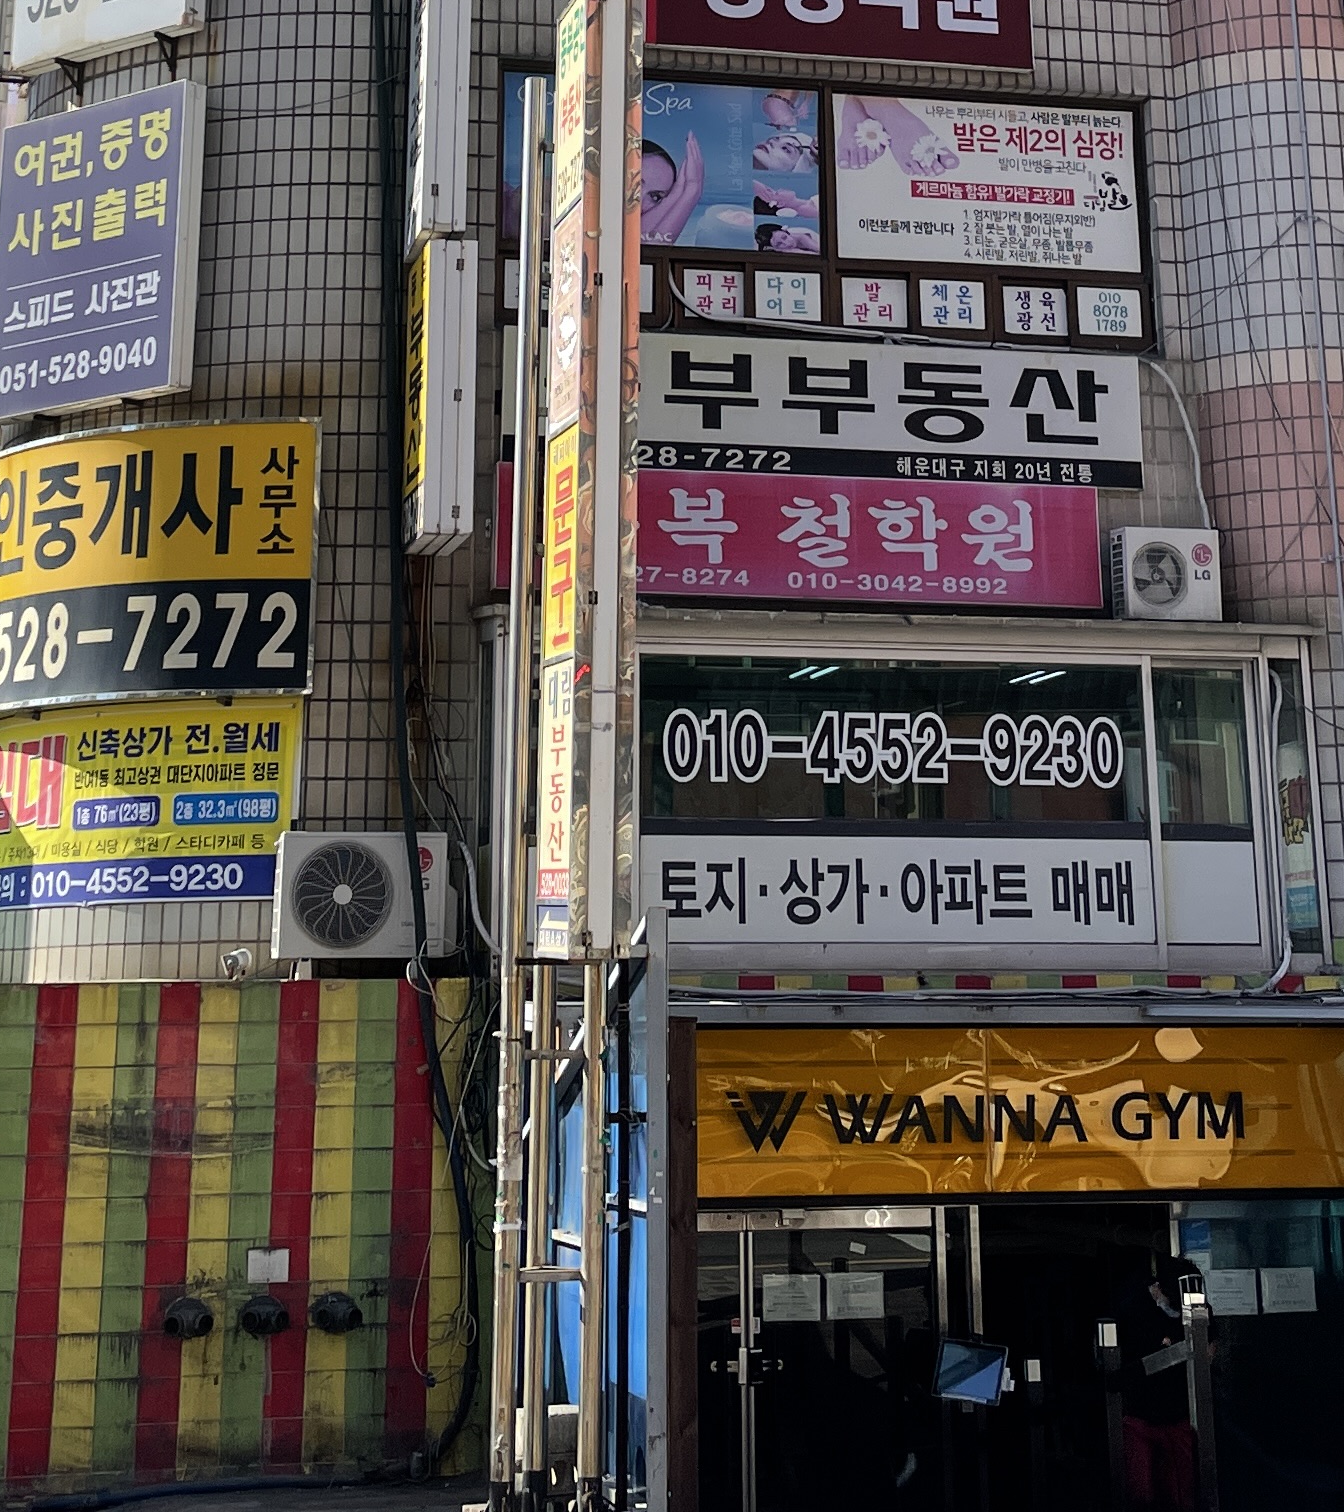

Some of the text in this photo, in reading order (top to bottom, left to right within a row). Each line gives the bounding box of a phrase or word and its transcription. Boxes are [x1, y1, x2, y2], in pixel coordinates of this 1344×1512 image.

[643, 83, 693, 115] Spa
[953, 123, 1067, 156] 발은 제2의
[696, 274, 737, 290] 피부
[865, 283, 1121, 304] 발 010
[3, 270, 161, 335] 스피드 사진관
[853, 303, 972, 325] 관리 관리
[1093, 305, 1128, 319] 8078
[1096, 318, 1127, 333] 1789
[0, 335, 157, 395] 051-528-9040
[897, 457, 1093, 484] 해운대구 지회 20년 전통
[778, 493, 1034, 573] 철학원
[788, 571, 1008, 595] 010-3042-8992
[1194, 569, 1212, 581] LG
[77, 726, 172, 762] 신축상가
[662, 708, 1125, 790] 010-4552-9230
[113, 762, 279, 787] 최고상권 대단지아파트 정문
[547, 724, 567, 862] 부동산
[32, 863, 243, 899] 010-4552-9230
[1054, 859, 1135, 926] 매매
[823, 1091, 1247, 1145] WANNA GYM
